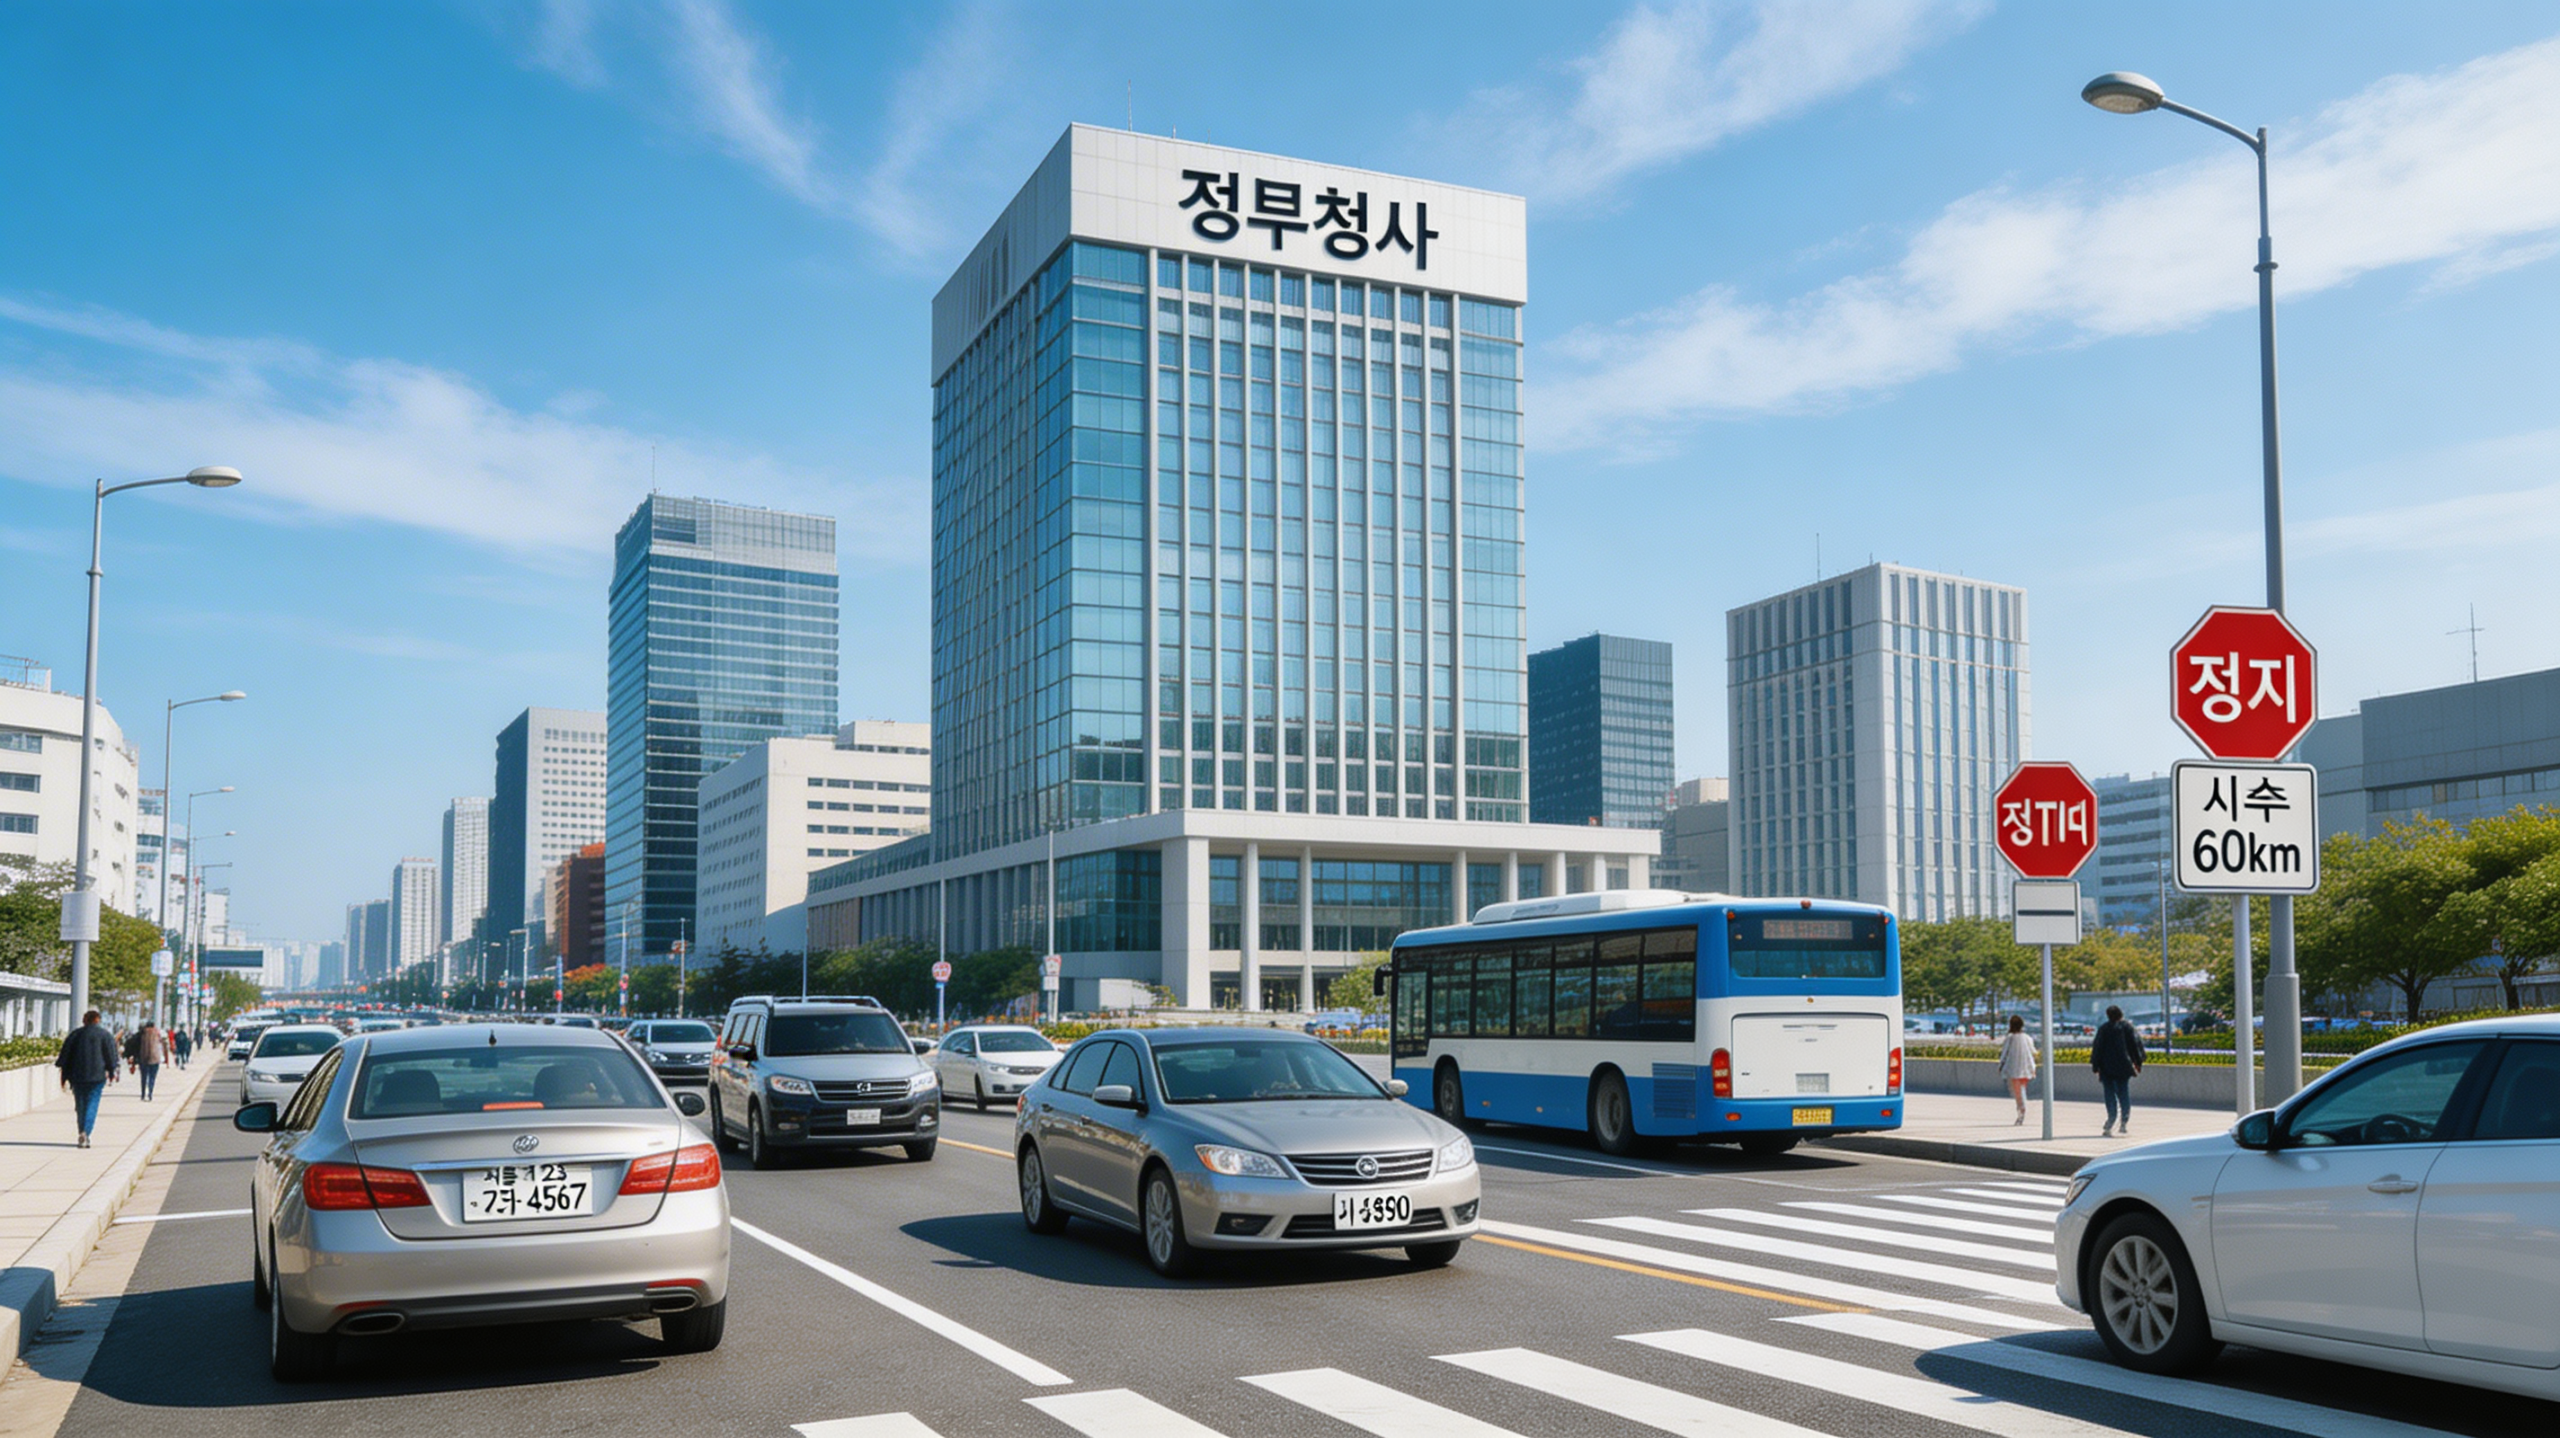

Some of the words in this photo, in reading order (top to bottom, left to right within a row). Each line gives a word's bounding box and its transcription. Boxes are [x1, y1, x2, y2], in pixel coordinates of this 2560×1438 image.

[2189, 652, 2296, 723] 정지
[2193, 829, 2300, 873] 60km
[527, 1183, 587, 1213] 4567
